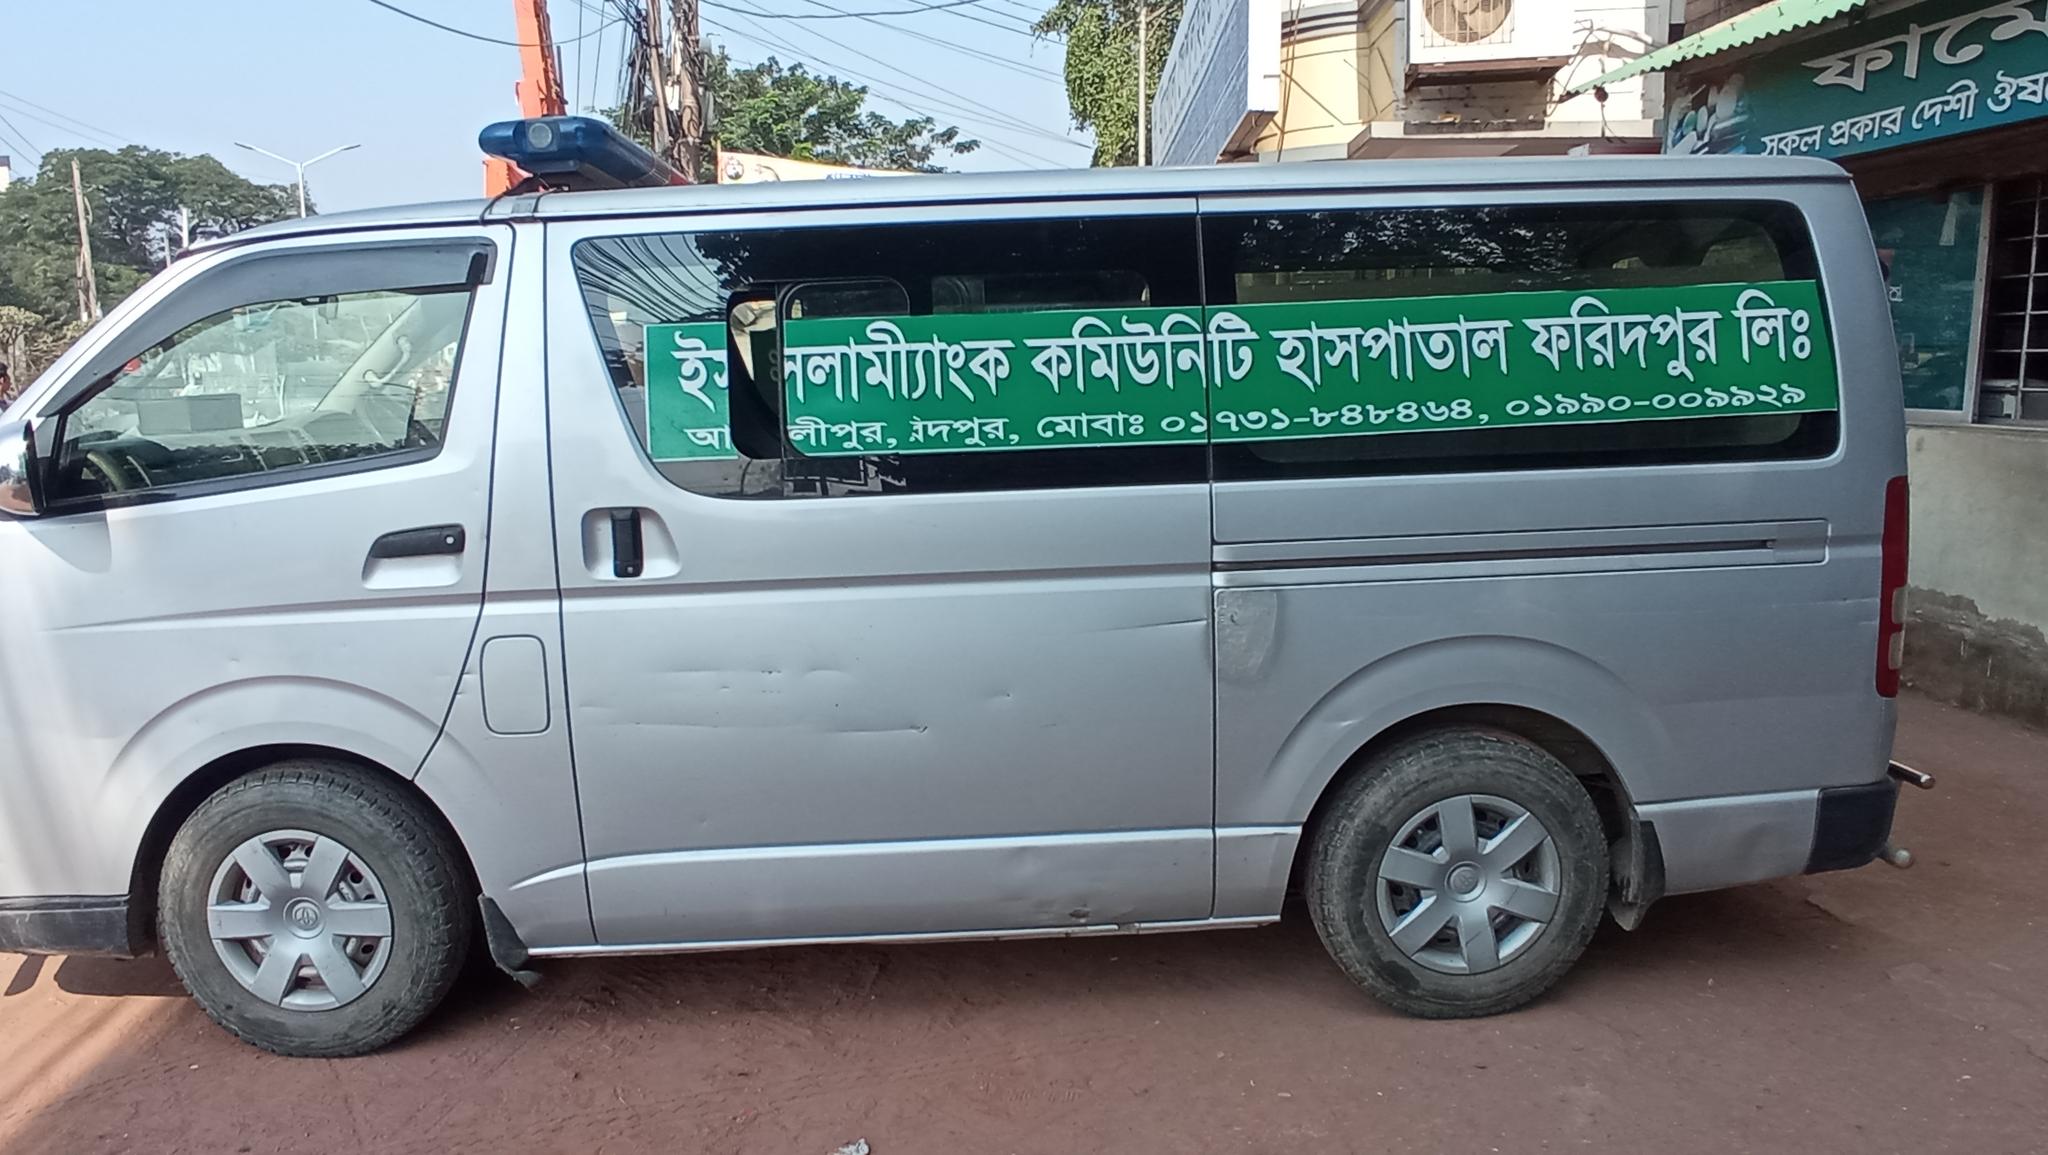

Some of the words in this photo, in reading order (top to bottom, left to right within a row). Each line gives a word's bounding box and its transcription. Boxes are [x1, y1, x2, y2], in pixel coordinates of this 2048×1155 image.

[1761, 125, 1824, 156] সকল
[1828, 106, 1905, 145] প্রকার
[1912, 79, 1979, 129] দেশী
[1987, 70, 2048, 112] ঔষ
[1023, 312, 1259, 394] কমিউনিটি
[1269, 316, 1514, 393] হাসপাতাল
[1522, 296, 1723, 381] ফরিদপুর
[1730, 289, 1812, 363] লিঃ
[1160, 401, 1489, 435] ০১৭৩১-৮৪৮৪৬৪,
[1505, 383, 1807, 417] ০১৯৯০-০০৯৯২৯
